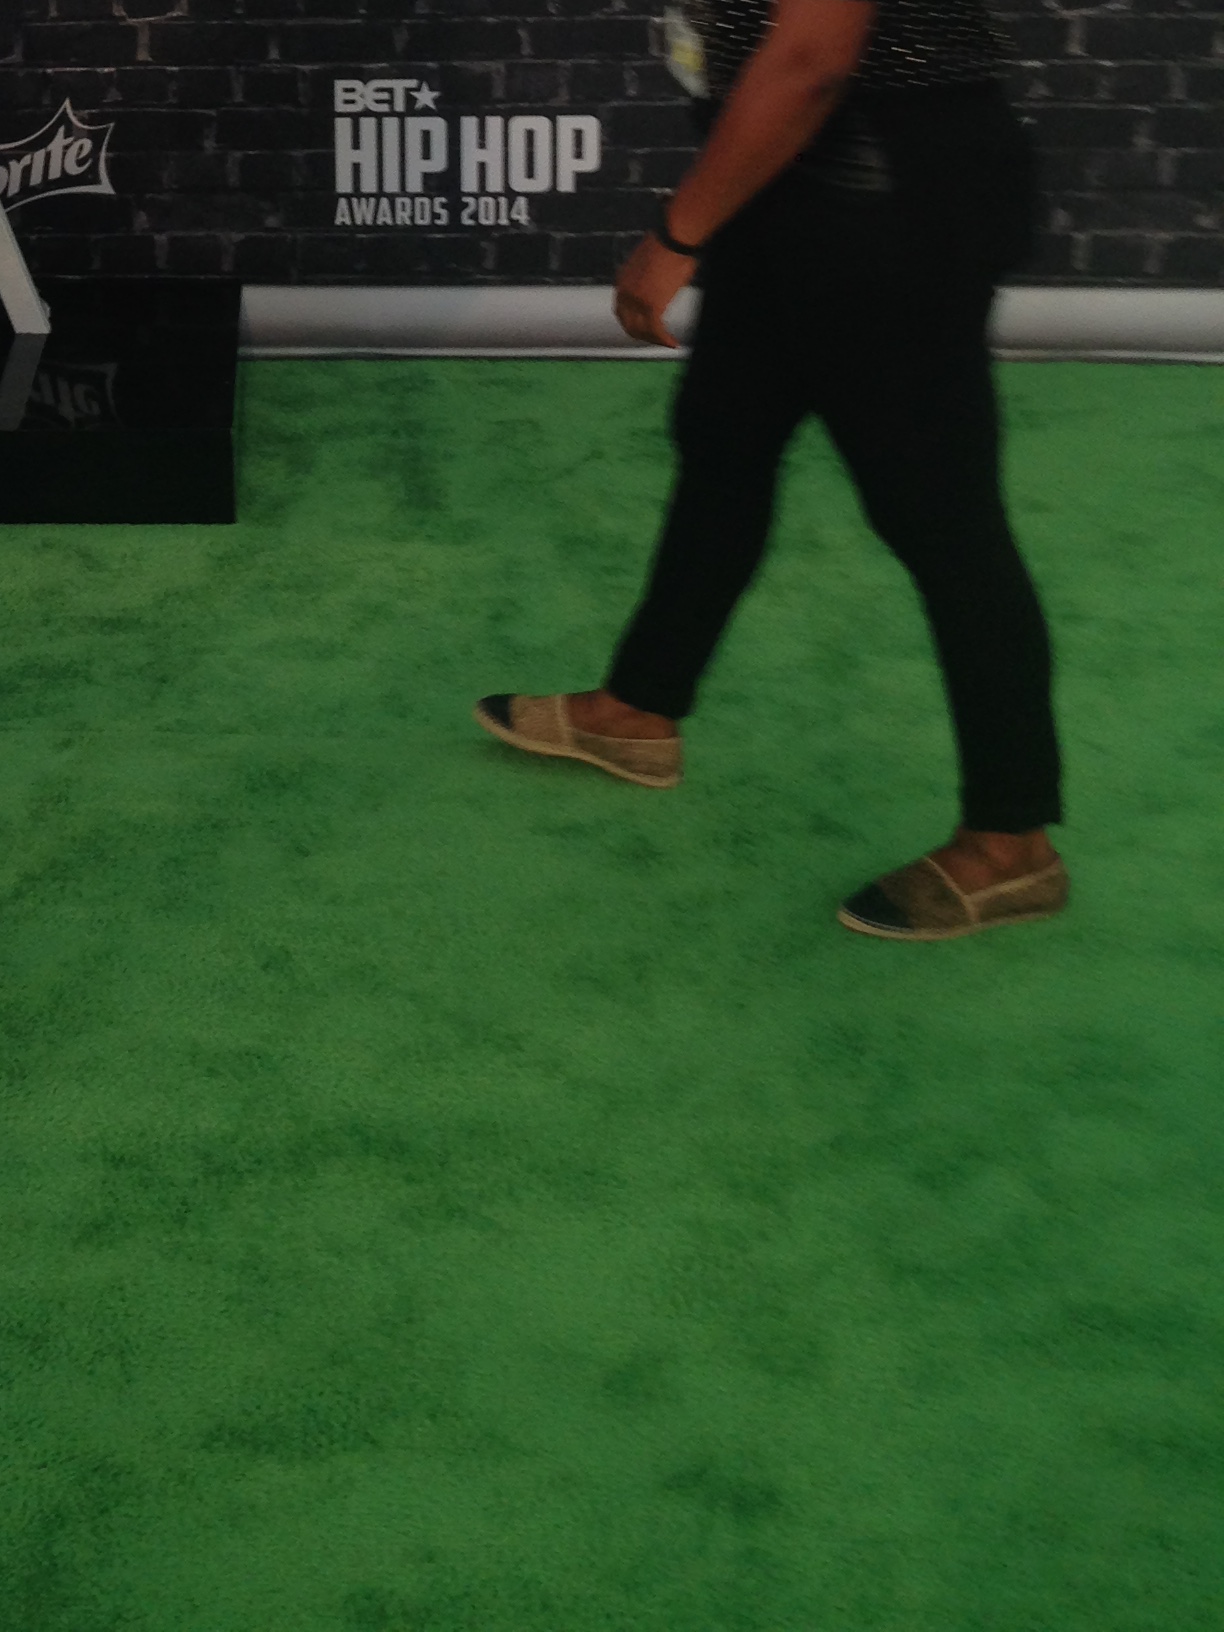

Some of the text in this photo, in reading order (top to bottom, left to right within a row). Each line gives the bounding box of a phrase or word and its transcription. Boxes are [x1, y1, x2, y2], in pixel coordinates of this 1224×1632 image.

[333, 78, 420, 112] BET
[334, 114, 602, 194] HIP HOP
[333, 195, 530, 226] AWARDS 2014
